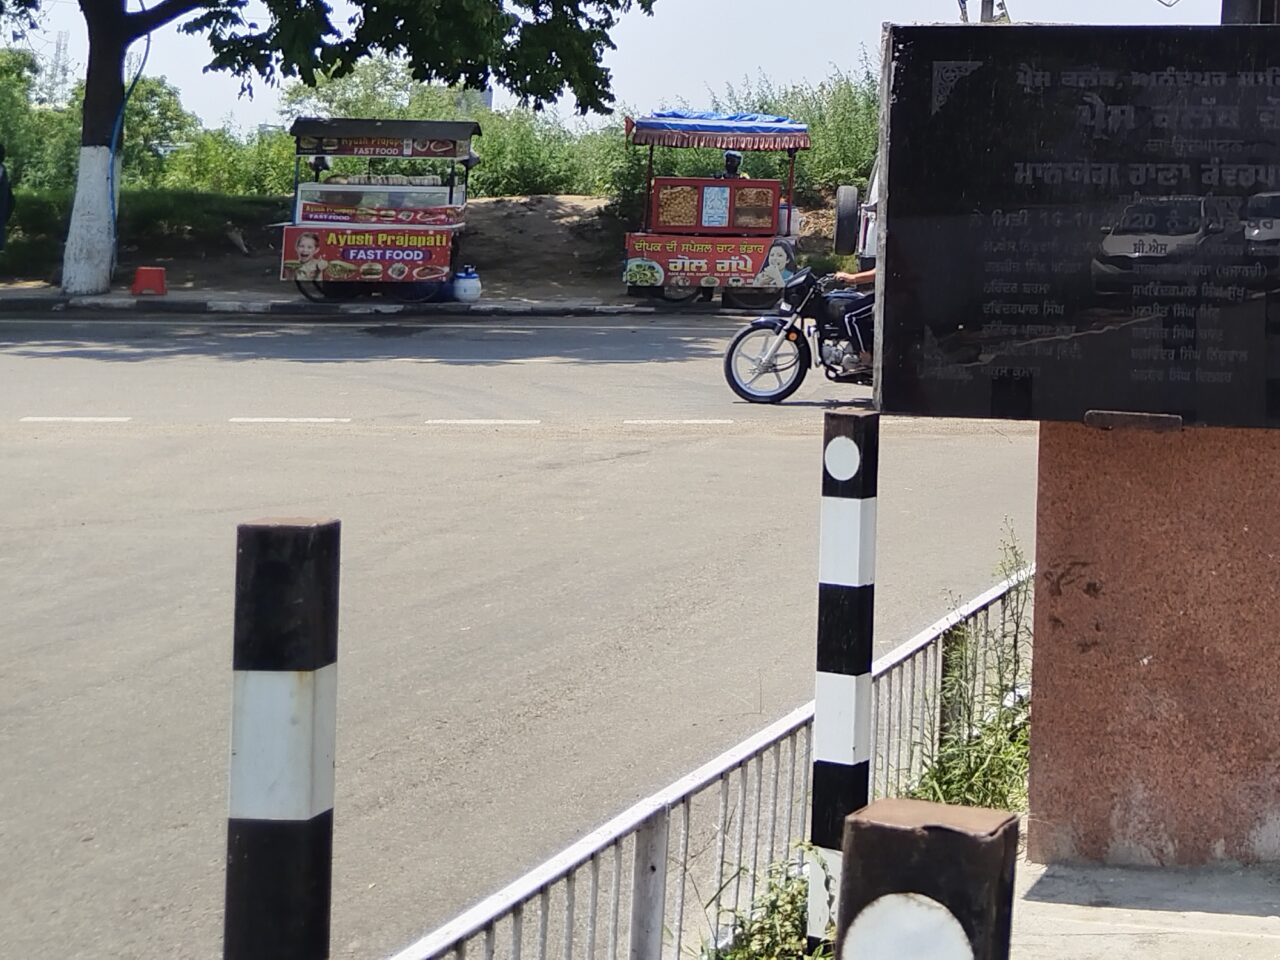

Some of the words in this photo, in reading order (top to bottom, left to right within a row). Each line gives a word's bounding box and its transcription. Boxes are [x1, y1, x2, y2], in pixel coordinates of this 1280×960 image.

[353, 147, 375, 155] FAST
[376, 147, 399, 155] FOOD
[326, 232, 374, 246] Ayush
[377, 232, 447, 247] Prajapati
[634, 240, 661, 253] ਦੀਪਕ
[666, 240, 677, 252] ਦੀ
[716, 244, 735, 253] ਚਾਟ
[350, 250, 383, 260] FAST
[385, 250, 424, 260] FOOD
[668, 254, 708, 272] ਗੋਲ
[716, 254, 753, 273] ਗੱਪੇ
